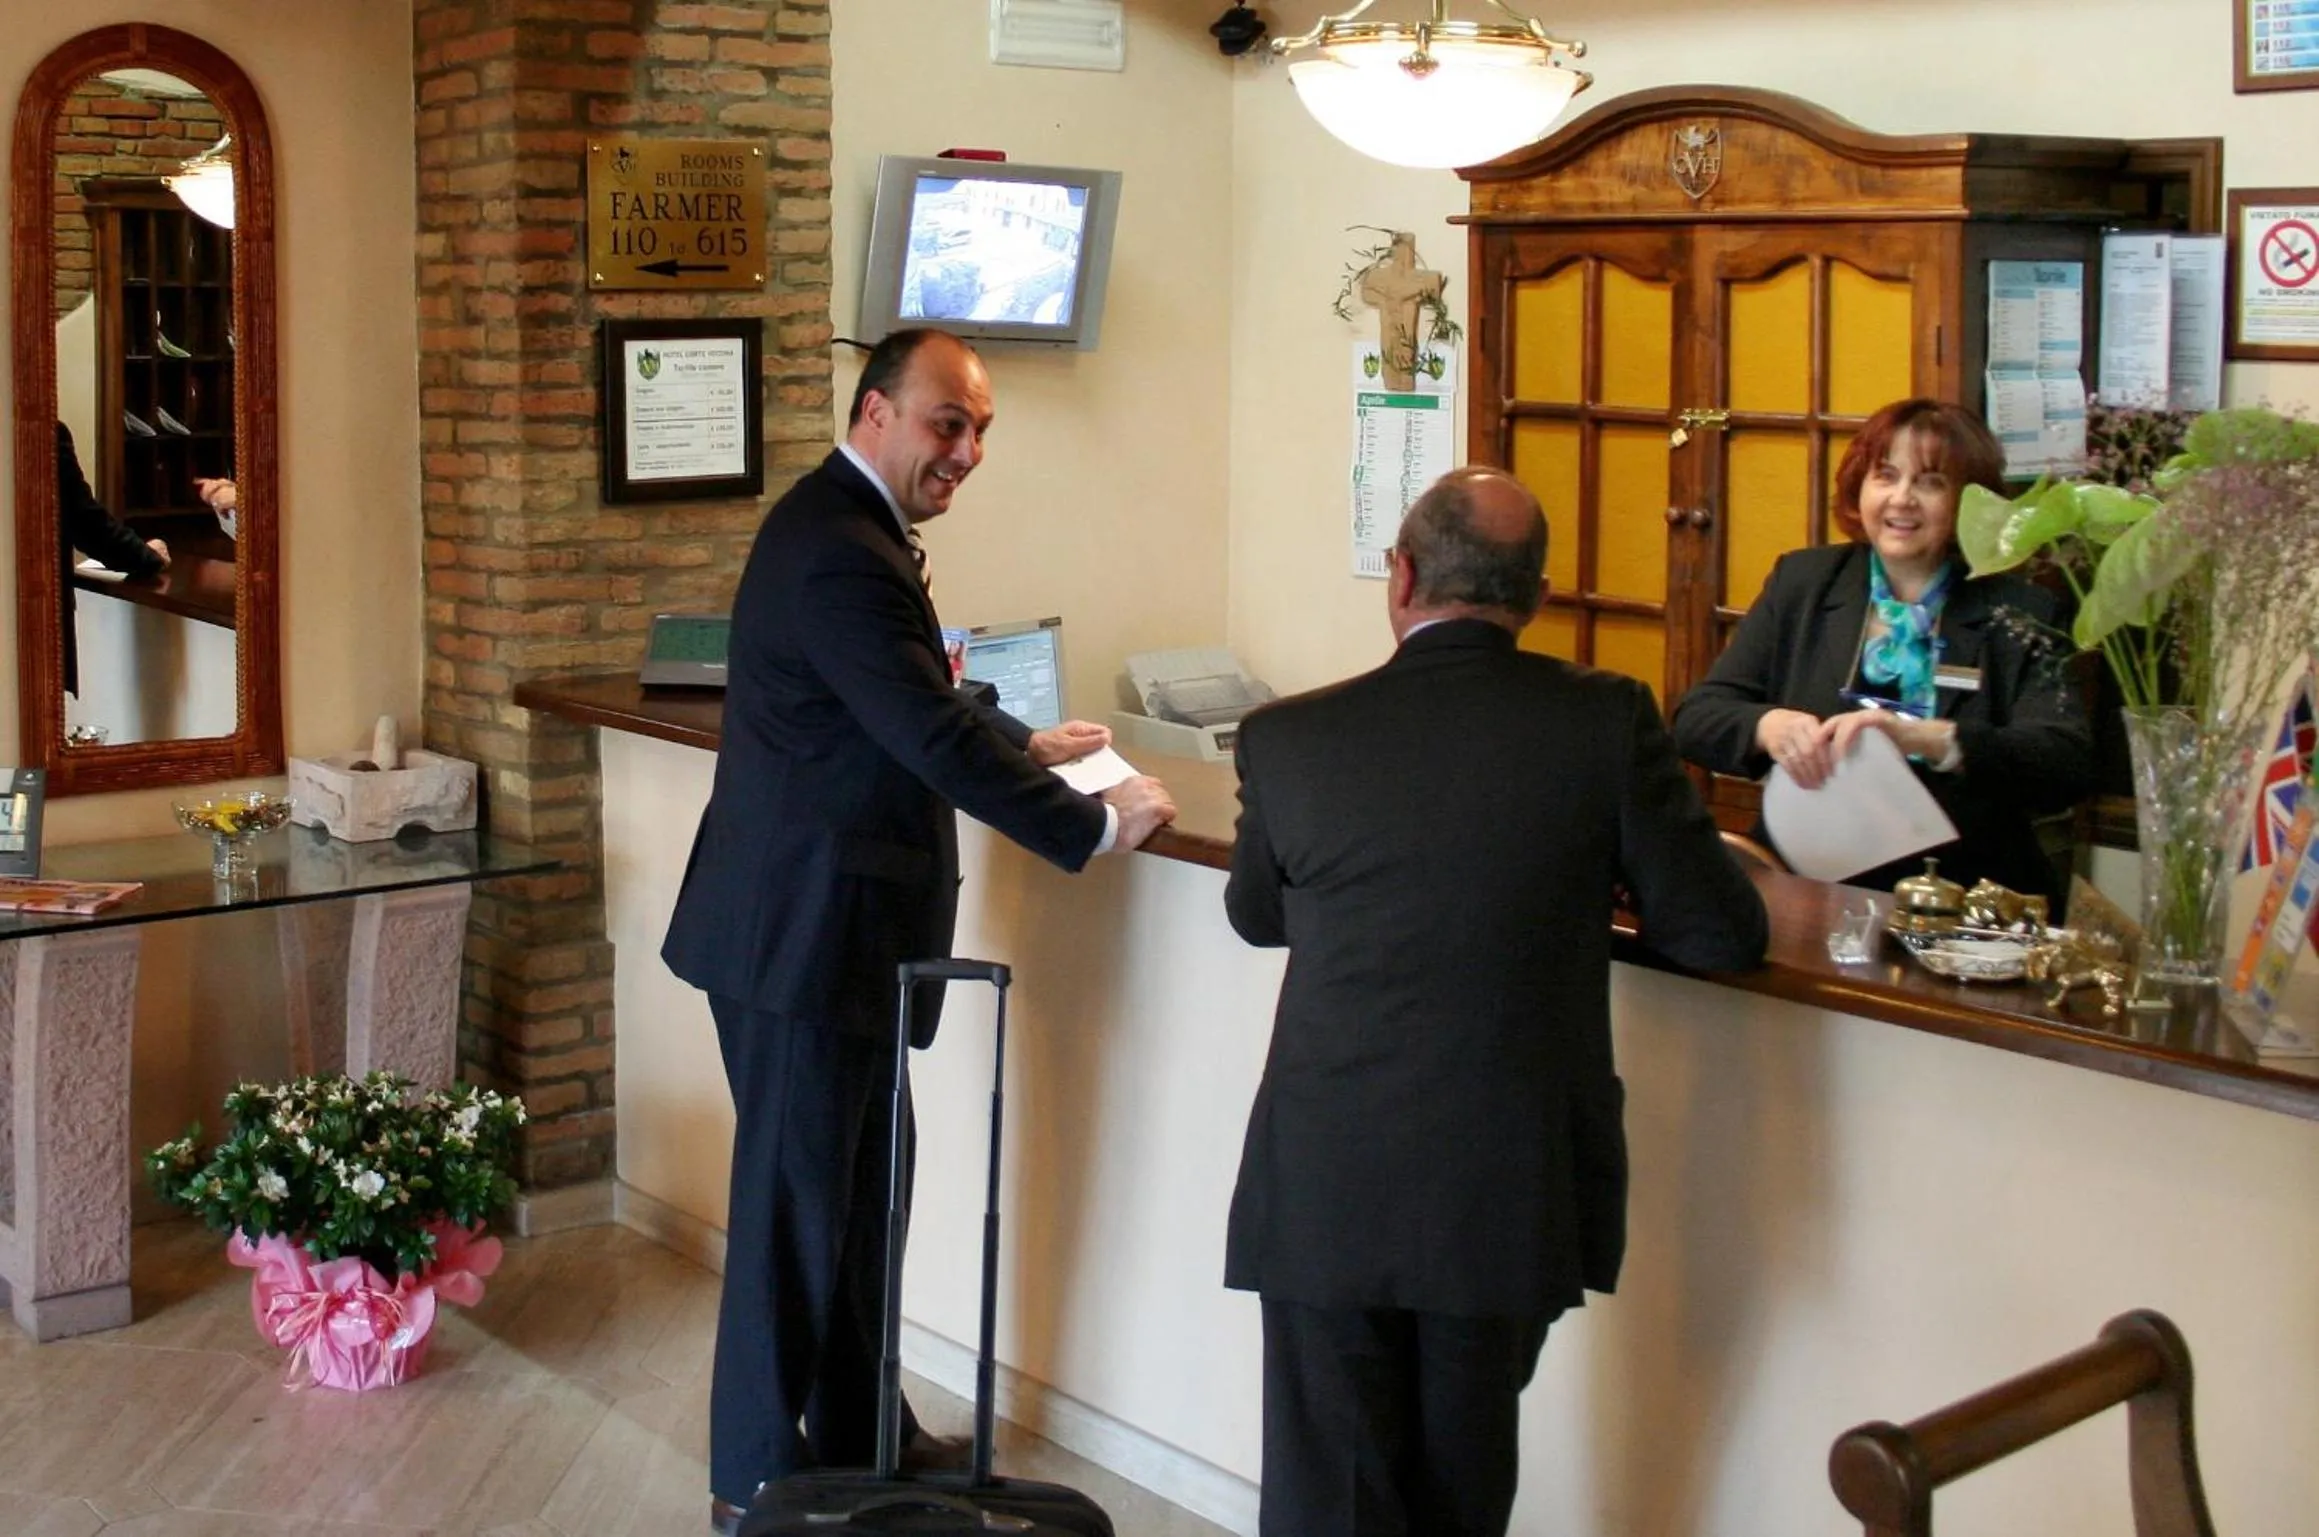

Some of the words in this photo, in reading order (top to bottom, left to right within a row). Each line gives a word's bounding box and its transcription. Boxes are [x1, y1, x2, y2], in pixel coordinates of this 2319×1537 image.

[680, 153, 745, 170] ROOMS
[655, 172, 745, 188] BUILDING
[610, 192, 747, 222] FARMER
[610, 227, 657, 256] 110
[669, 241, 686, 254] to
[697, 228, 748, 257] 615
